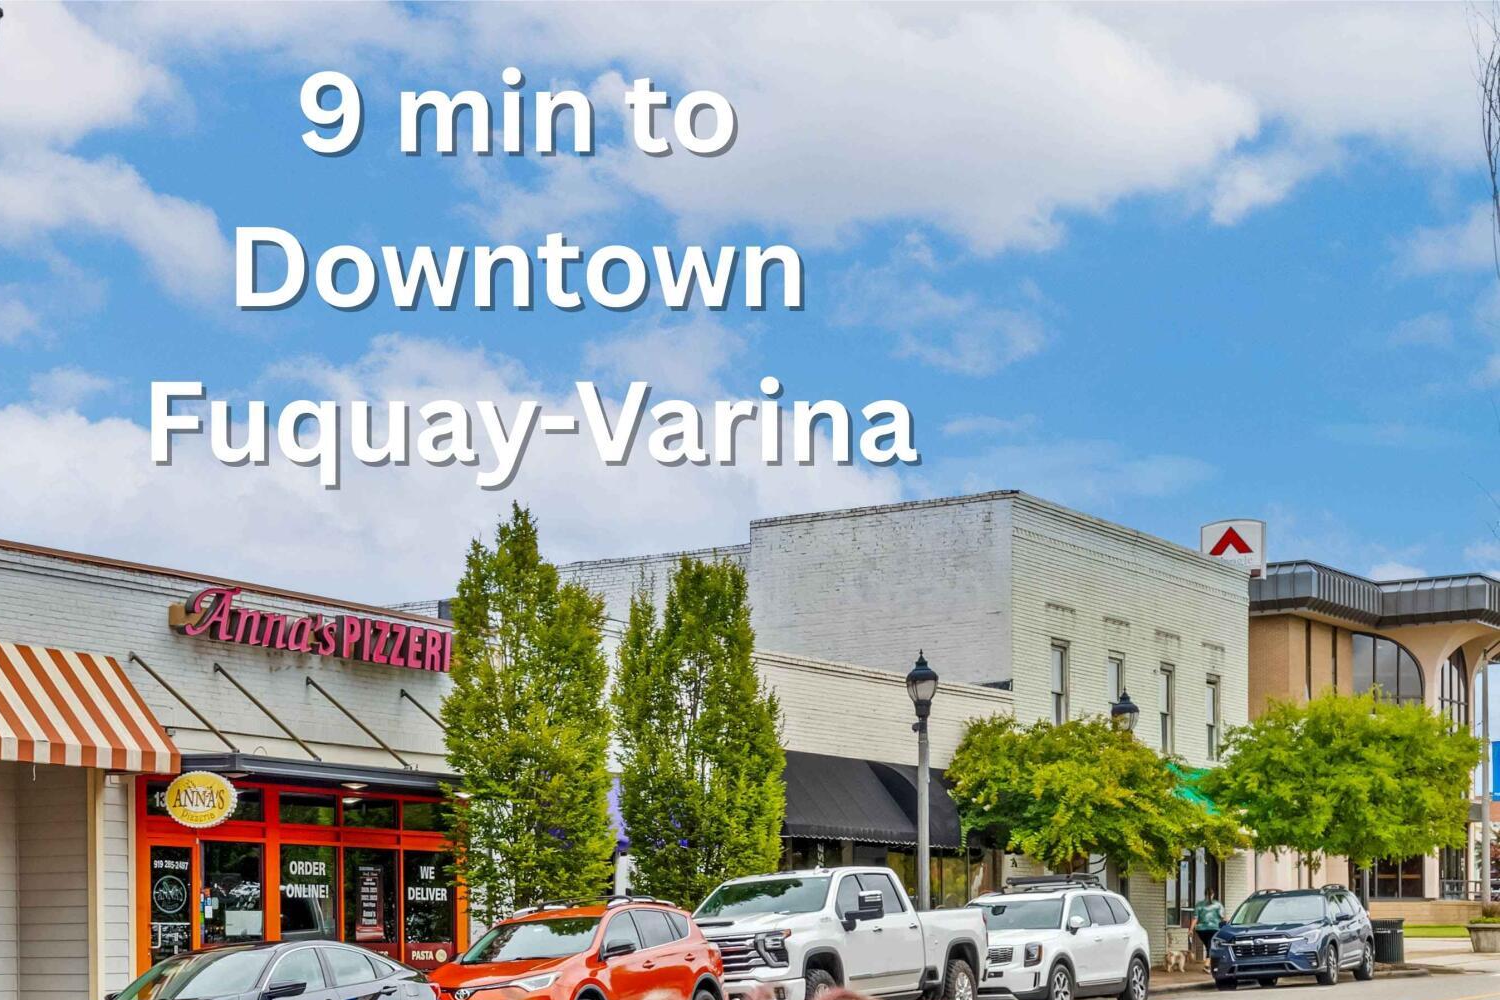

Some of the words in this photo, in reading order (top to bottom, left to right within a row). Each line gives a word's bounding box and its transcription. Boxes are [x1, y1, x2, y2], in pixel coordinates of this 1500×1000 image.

[184, 586, 337, 656] Anna's
[342, 615, 451, 673] PIZZERI
[154, 791, 166, 808] 13
[172, 788, 225, 810] ANNA'S
[153, 859, 164, 869] 919
[289, 860, 326, 876] ORDER
[419, 865, 435, 880] WE
[286, 883, 329, 899] ONLINE!
[407, 886, 448, 902] DELIVER
[411, 950, 434, 961] PASTA
